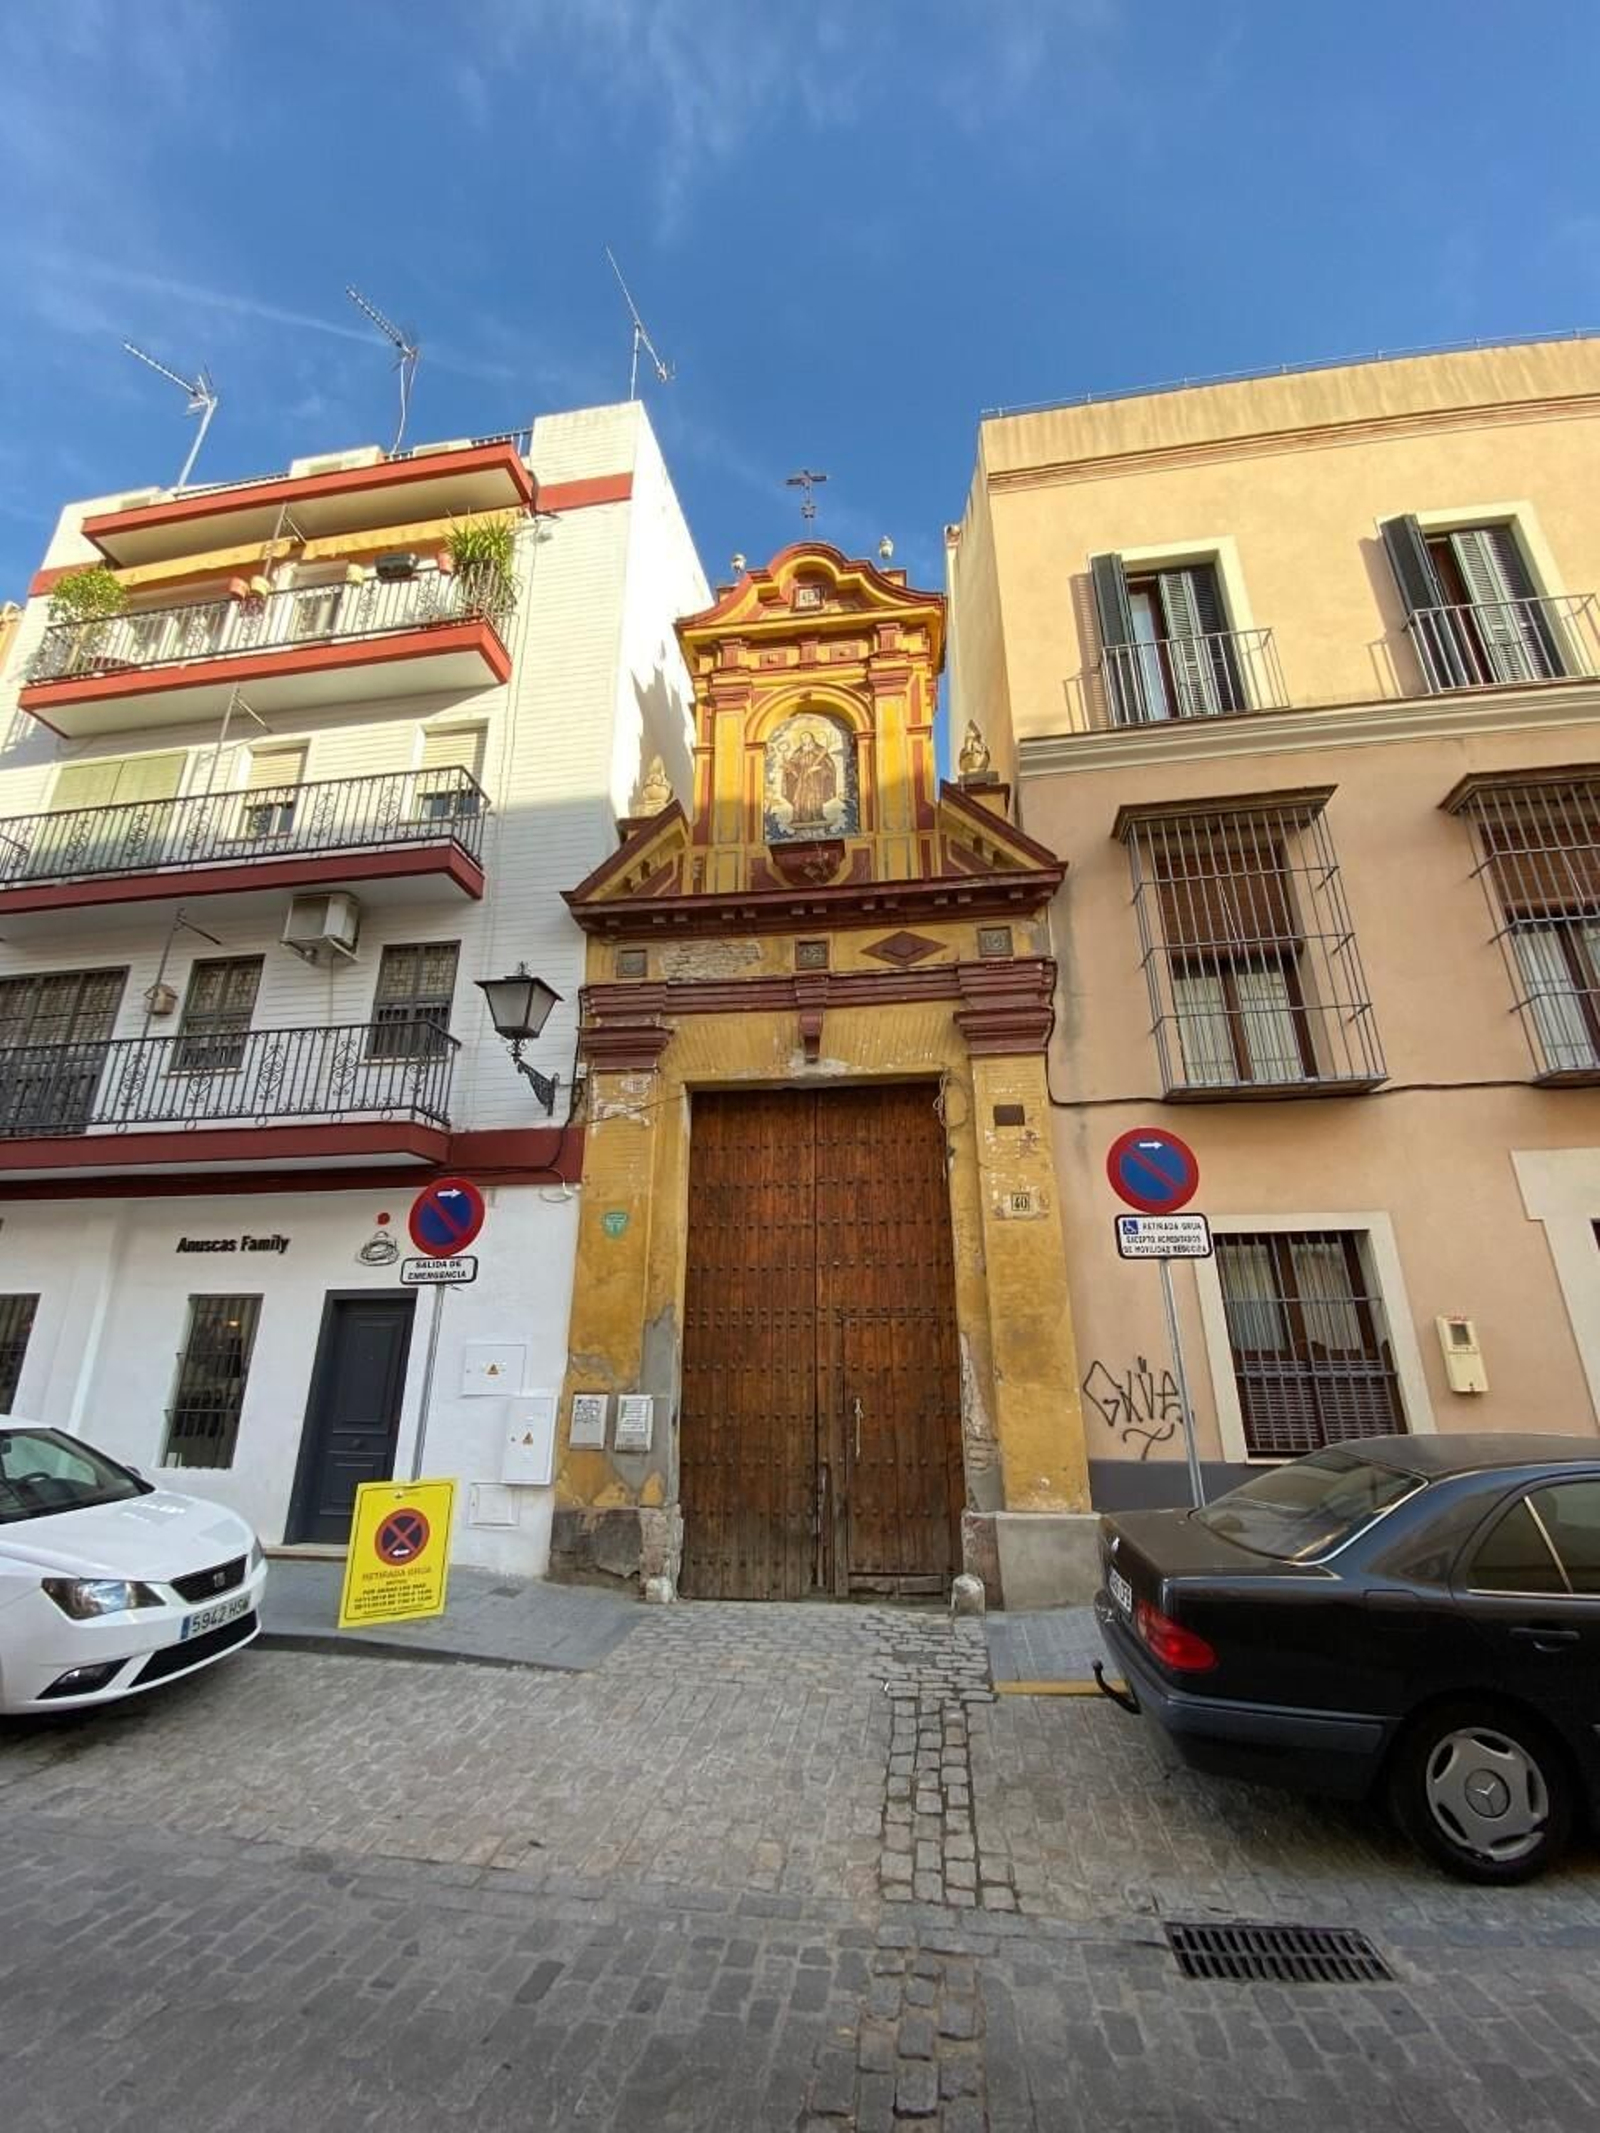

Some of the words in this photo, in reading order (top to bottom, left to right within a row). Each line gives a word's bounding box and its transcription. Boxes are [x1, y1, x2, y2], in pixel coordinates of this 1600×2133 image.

[1014, 1195, 1028, 1209] 40
[1142, 1222, 1179, 1231] RETIRADA
[1181, 1222, 1202, 1230] GRUA
[176, 1237, 237, 1253] Anuscas
[240, 1235, 290, 1254] Family
[416, 1260, 447, 1268] SALIDA
[449, 1260, 462, 1268] DE
[408, 1270, 467, 1280] EMERGENCIA
[191, 1605, 227, 1632] 5942
